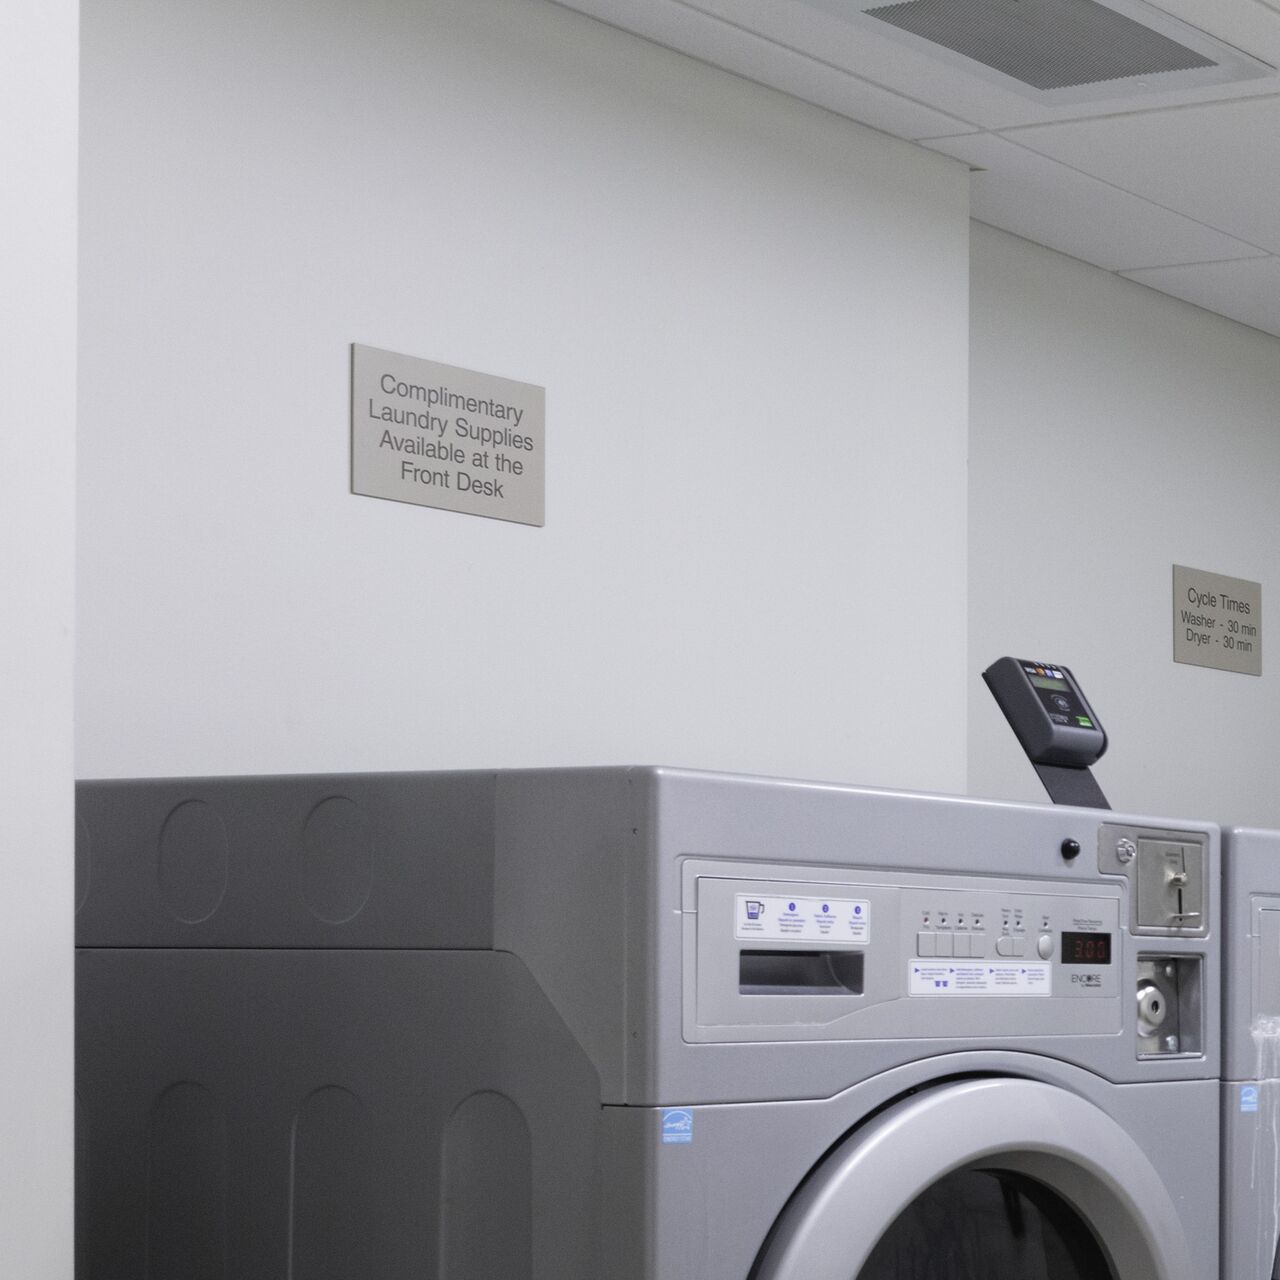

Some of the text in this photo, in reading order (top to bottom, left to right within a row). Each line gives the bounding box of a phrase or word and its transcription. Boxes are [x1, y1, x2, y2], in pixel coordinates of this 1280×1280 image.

[380, 373, 524, 427] Complimentary
[369, 398, 534, 451] Laundry Supplies
[379, 429, 523, 476] Available at the
[401, 460, 504, 499] Front Desk
[1187, 587, 1251, 615] Cycle Times
[1180, 609, 1216, 629] Washer
[1227, 619, 1239, 634] 30
[1241, 623, 1257, 637] min
[1186, 628, 1211, 647] Dryer
[1223, 635, 1235, 649] 30
[1236, 639, 1253, 652] min
